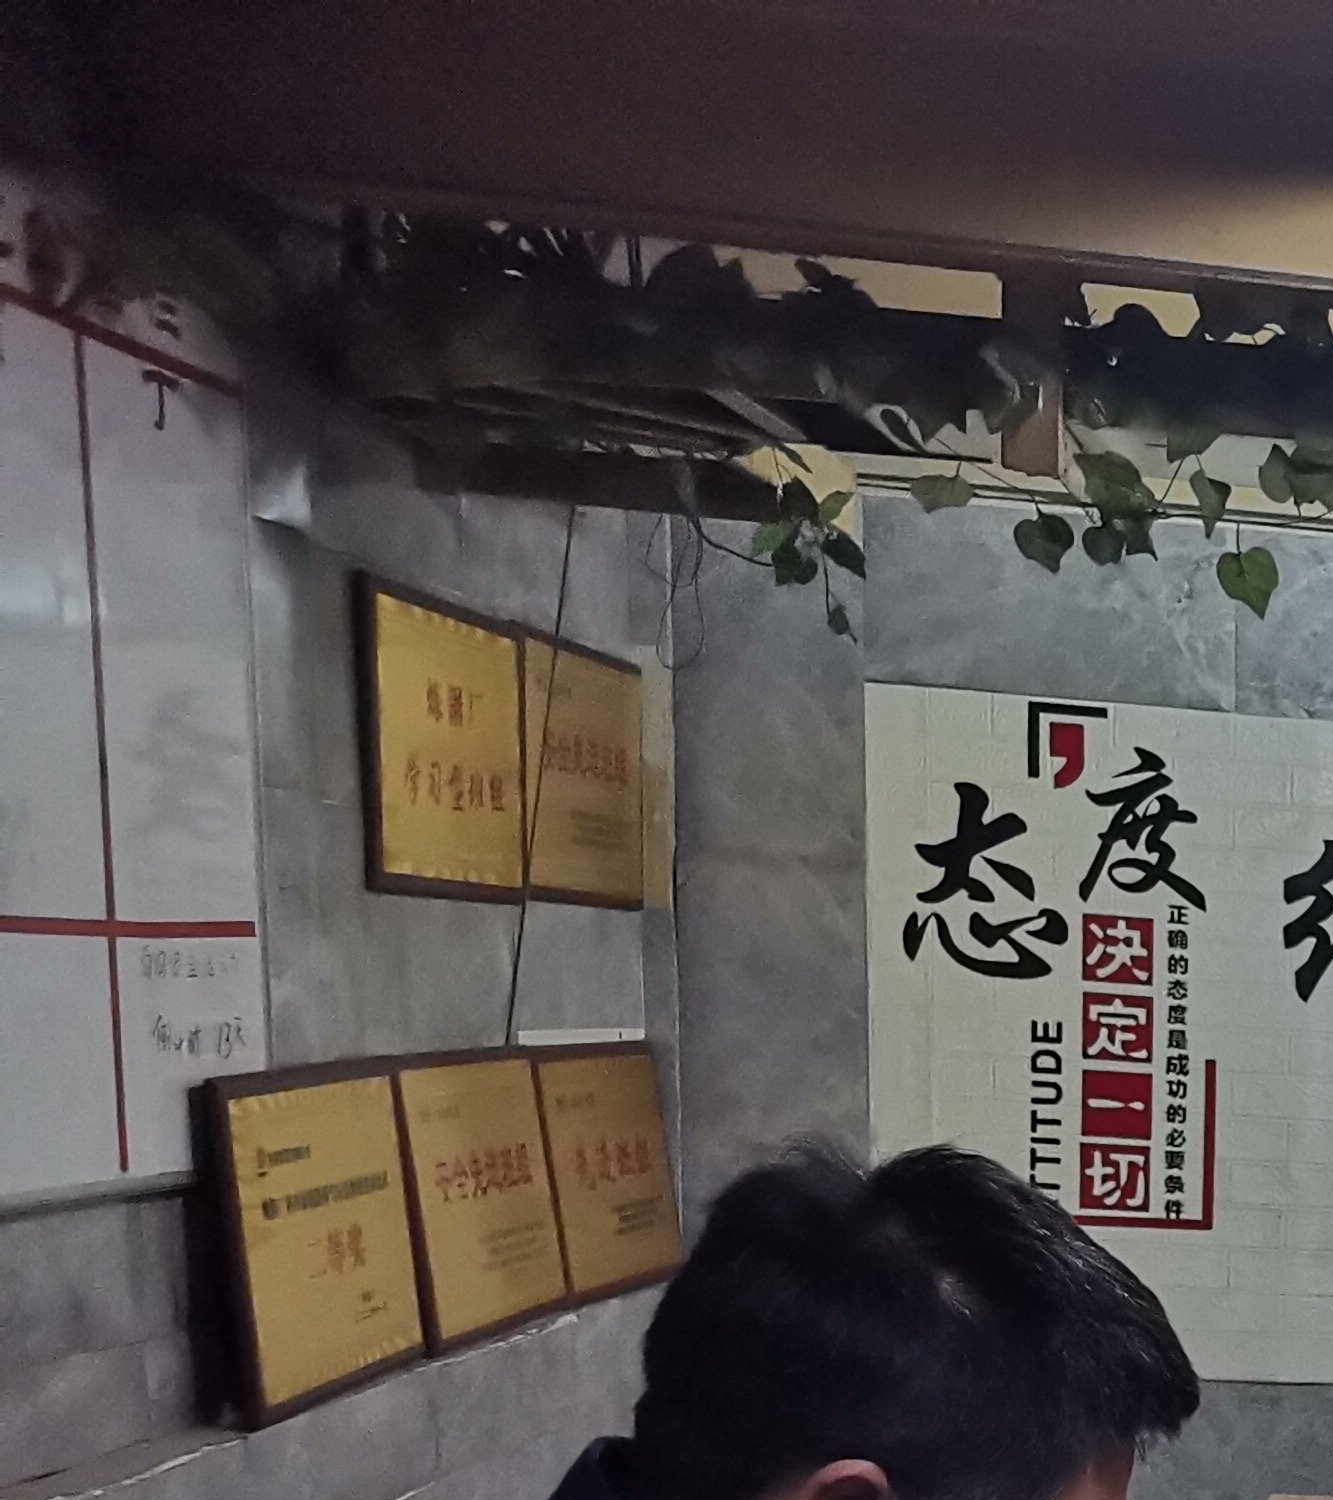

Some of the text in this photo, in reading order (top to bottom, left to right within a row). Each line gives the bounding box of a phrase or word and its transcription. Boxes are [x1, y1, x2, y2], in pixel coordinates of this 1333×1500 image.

[902, 747, 1207, 979] 态度
[1083, 917, 1150, 1209] 决定一切
[1164, 904, 1190, 1221] 正确的态度是成功的必要条件
